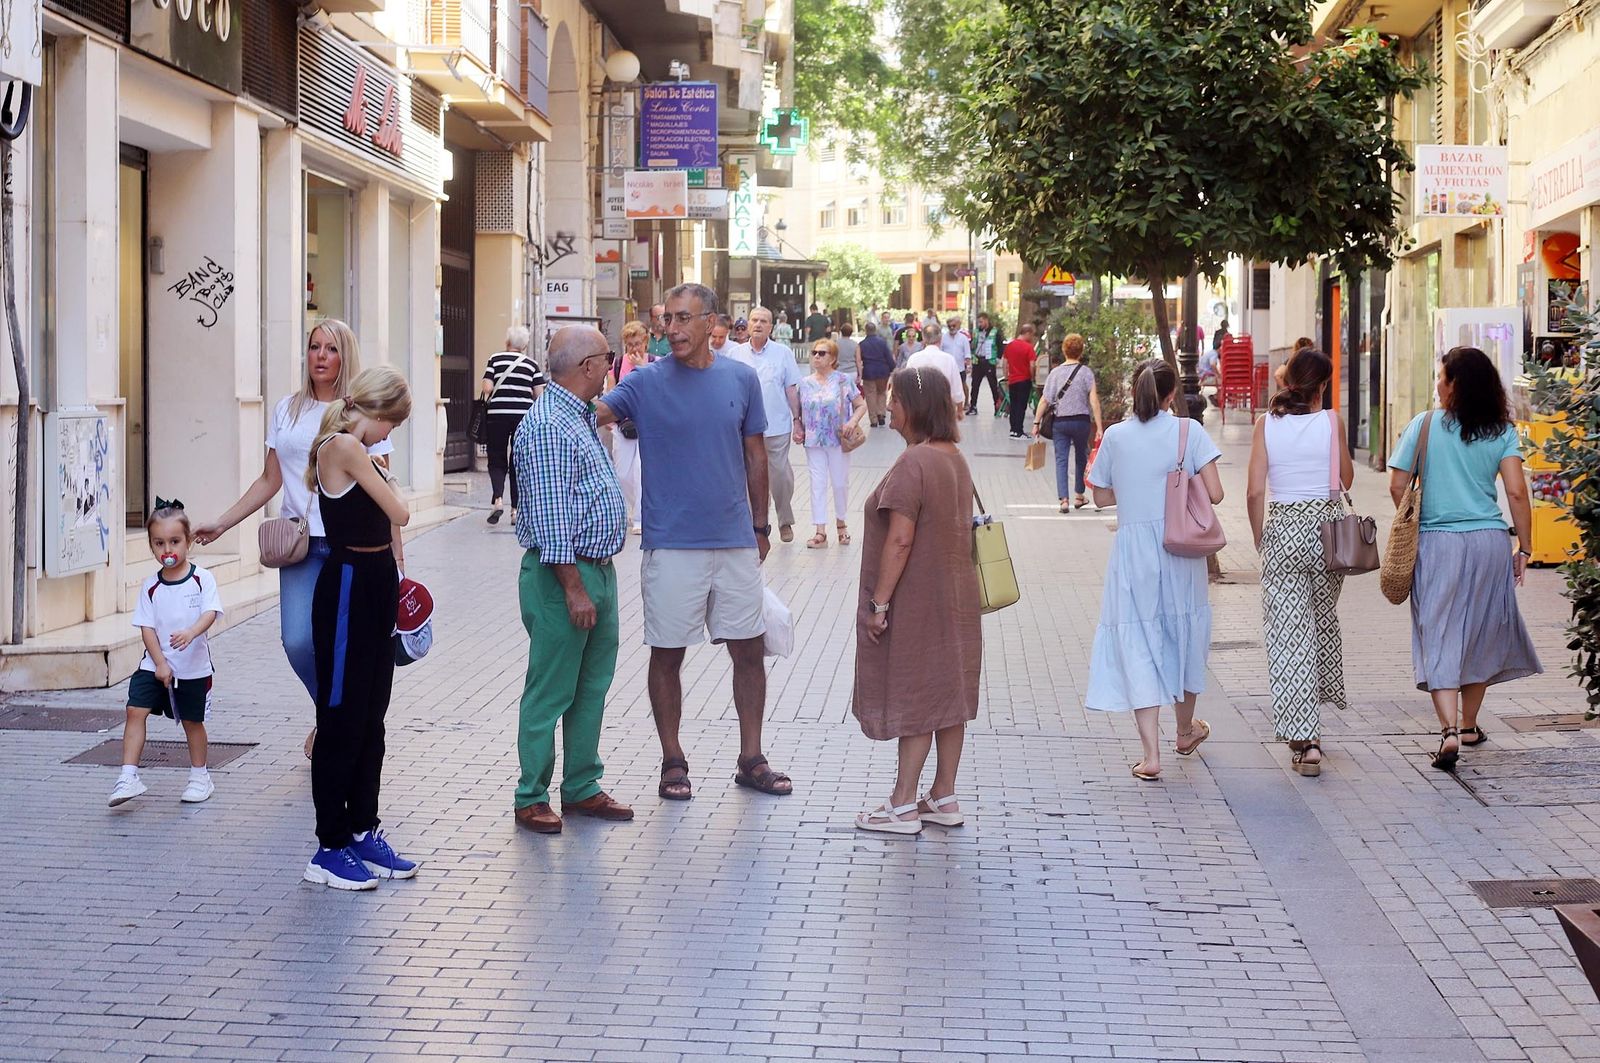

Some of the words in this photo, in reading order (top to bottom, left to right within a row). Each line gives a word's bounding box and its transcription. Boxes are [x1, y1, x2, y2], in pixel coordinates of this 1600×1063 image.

[669, 87, 681, 99] De
[681, 87, 715, 99] Estética
[610, 104, 627, 180] SEIKO
[1440, 152, 1483, 162] BAZAR
[1435, 177, 1443, 187] Y
[1445, 177, 1490, 187] FRUTAS
[1537, 153, 1584, 210] ESTRELLA
[735, 157, 752, 251] FARMACIA
[546, 282, 569, 293] EAG
